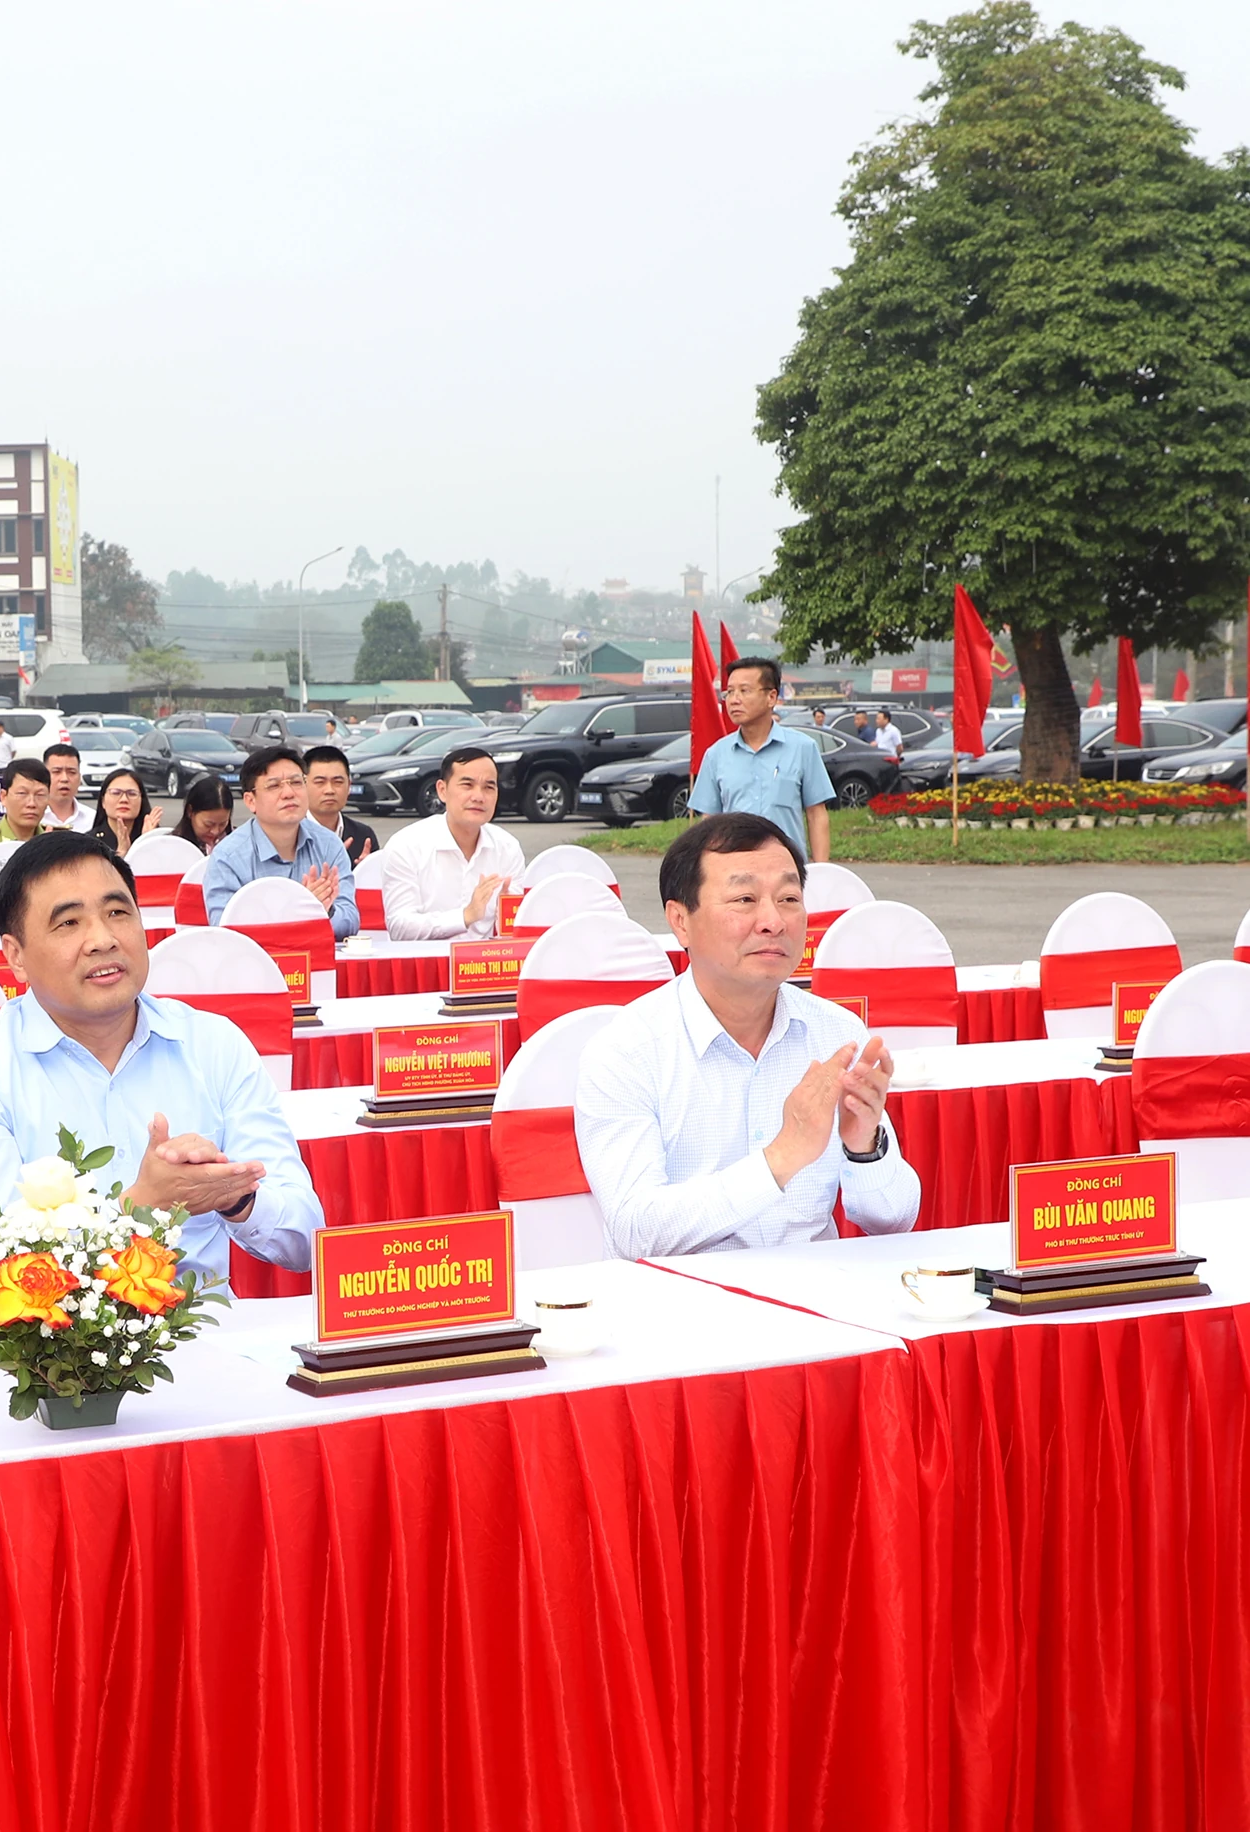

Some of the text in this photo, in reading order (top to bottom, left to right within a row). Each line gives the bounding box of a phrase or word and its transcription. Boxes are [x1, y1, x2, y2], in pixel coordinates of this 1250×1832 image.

[488, 960, 500, 976] THỊ
[502, 960, 518, 973] KIM
[416, 1033, 459, 1046] ĐỒNG CHÍ
[384, 1050, 491, 1073] NGUYỄN VIỆT PHƯƠNG
[1066, 1173, 1122, 1192] ĐỒNG CHÍ
[1033, 1195, 1155, 1231] BÙI VĂN QUANG
[382, 1234, 449, 1256] ĐỒNG CHÍ
[1045, 1240, 1058, 1248] PHÓ
[1066, 1238, 1078, 1246] THƯ
[339, 1253, 493, 1299] NGUYỄN QUỐC TRỊ
[386, 1304, 396, 1314] BỘ
[396, 1303, 416, 1313] NÔNG
[440, 1299, 450, 1308] VÀ
[450, 1298, 464, 1306] MÔI
